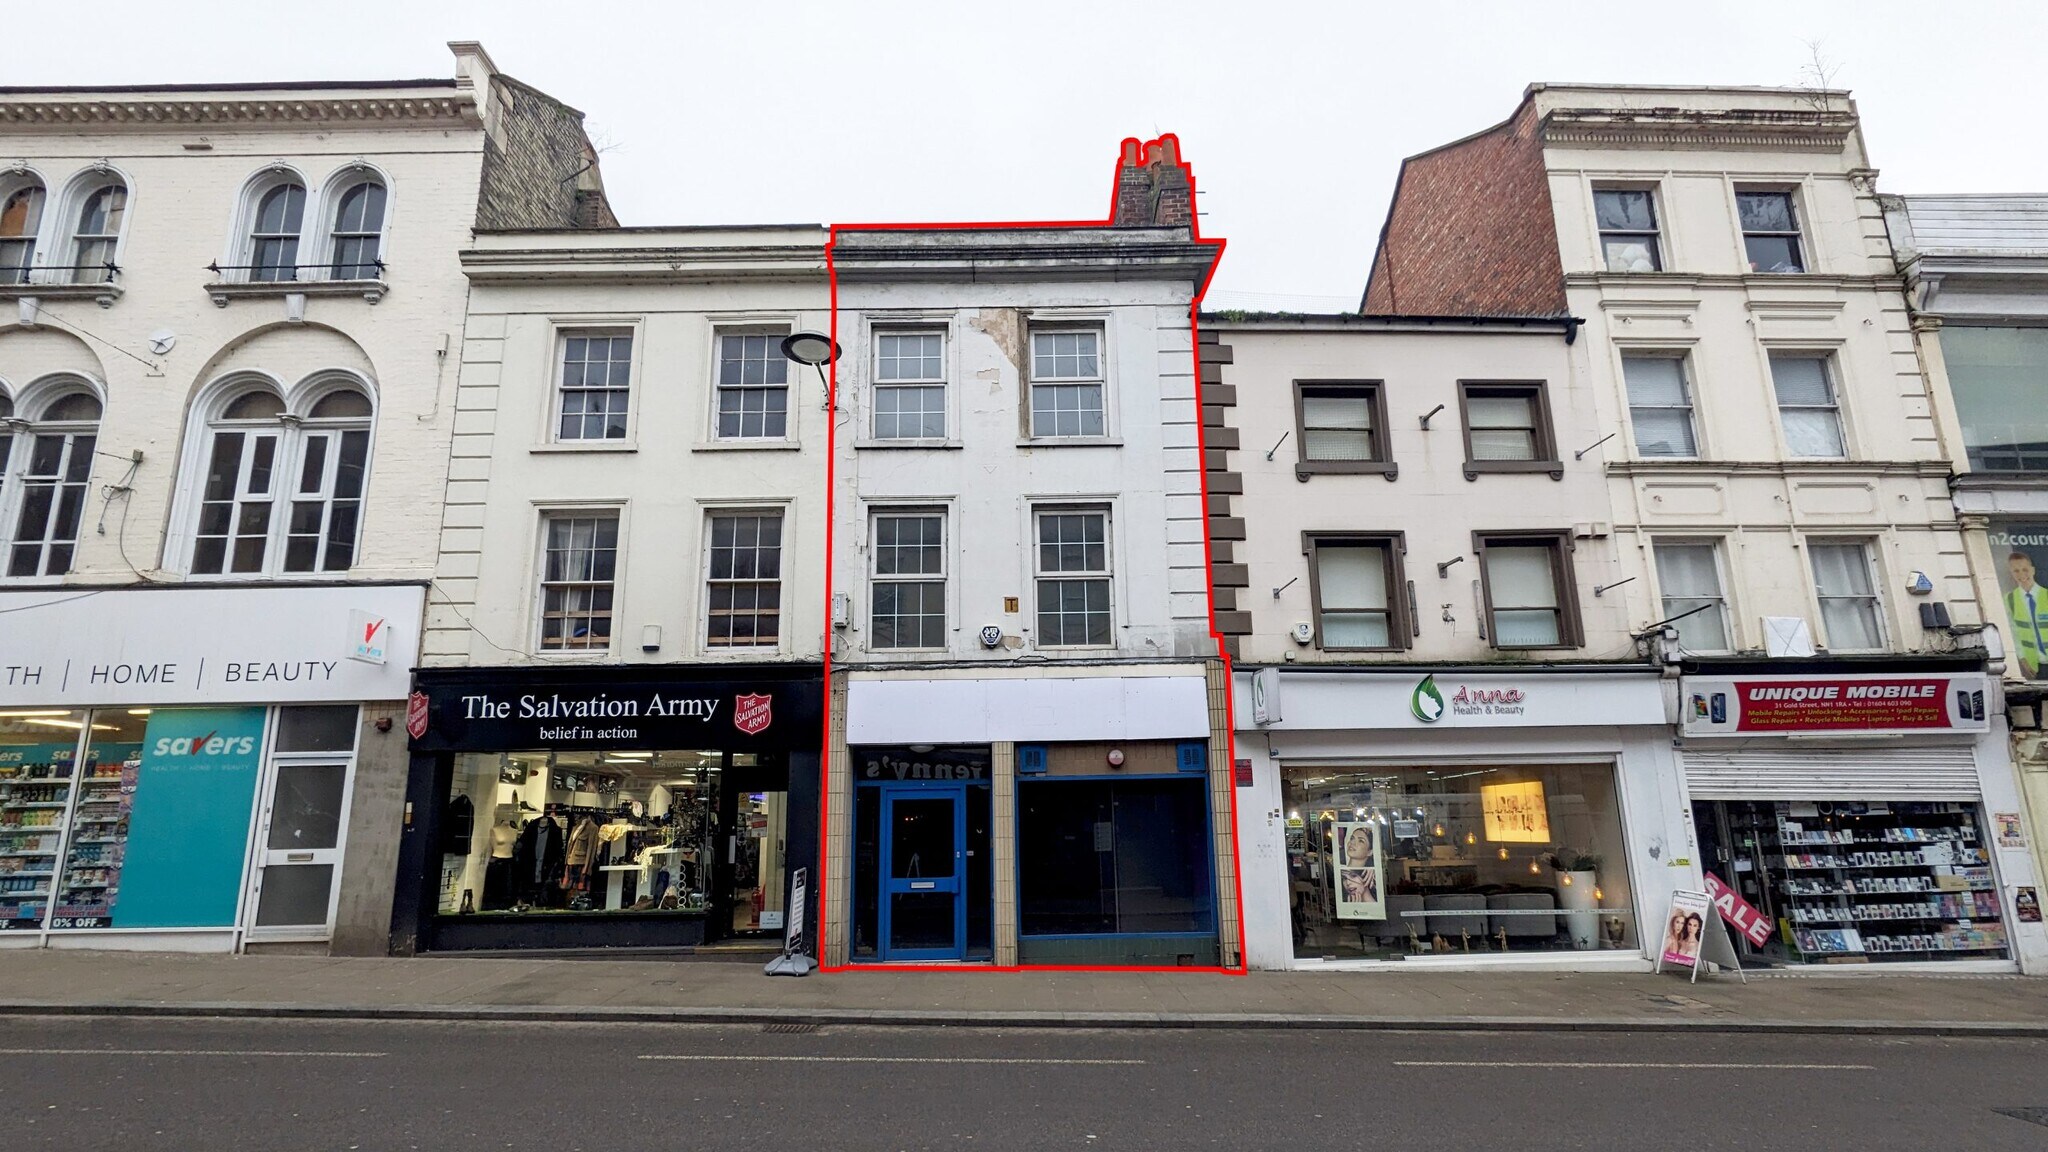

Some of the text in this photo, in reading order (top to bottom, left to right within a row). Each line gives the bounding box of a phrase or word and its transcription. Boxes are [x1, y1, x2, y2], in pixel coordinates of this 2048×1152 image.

[1989, 532, 2048, 546] n2cour
[5, 661, 339, 686] TH HOME BEAUTY
[1453, 685, 1526, 705] Anna
[1749, 685, 1937, 702] UNIQUE MOBILE
[461, 693, 720, 722] The Salvation Army
[736, 700, 769, 724] SALVATION
[743, 698, 756, 710] THE
[1453, 705, 1525, 717] Health & Beauty
[1773, 709, 1800, 717] Repairs
[1807, 708, 1842, 716] Unlocking
[1848, 707, 1889, 715] Accessories
[747, 712, 767, 730] ARMY
[1771, 717, 1798, 725] Repairs
[1804, 716, 1831, 724] Recycle
[1867, 715, 1896, 723] Laptops
[1902, 714, 1915, 722] Buy
[1925, 714, 1939, 722] Sell
[539, 725, 638, 740] belief in action
[153, 730, 255, 757] savers
[1703, 878, 1771, 943] SALE
